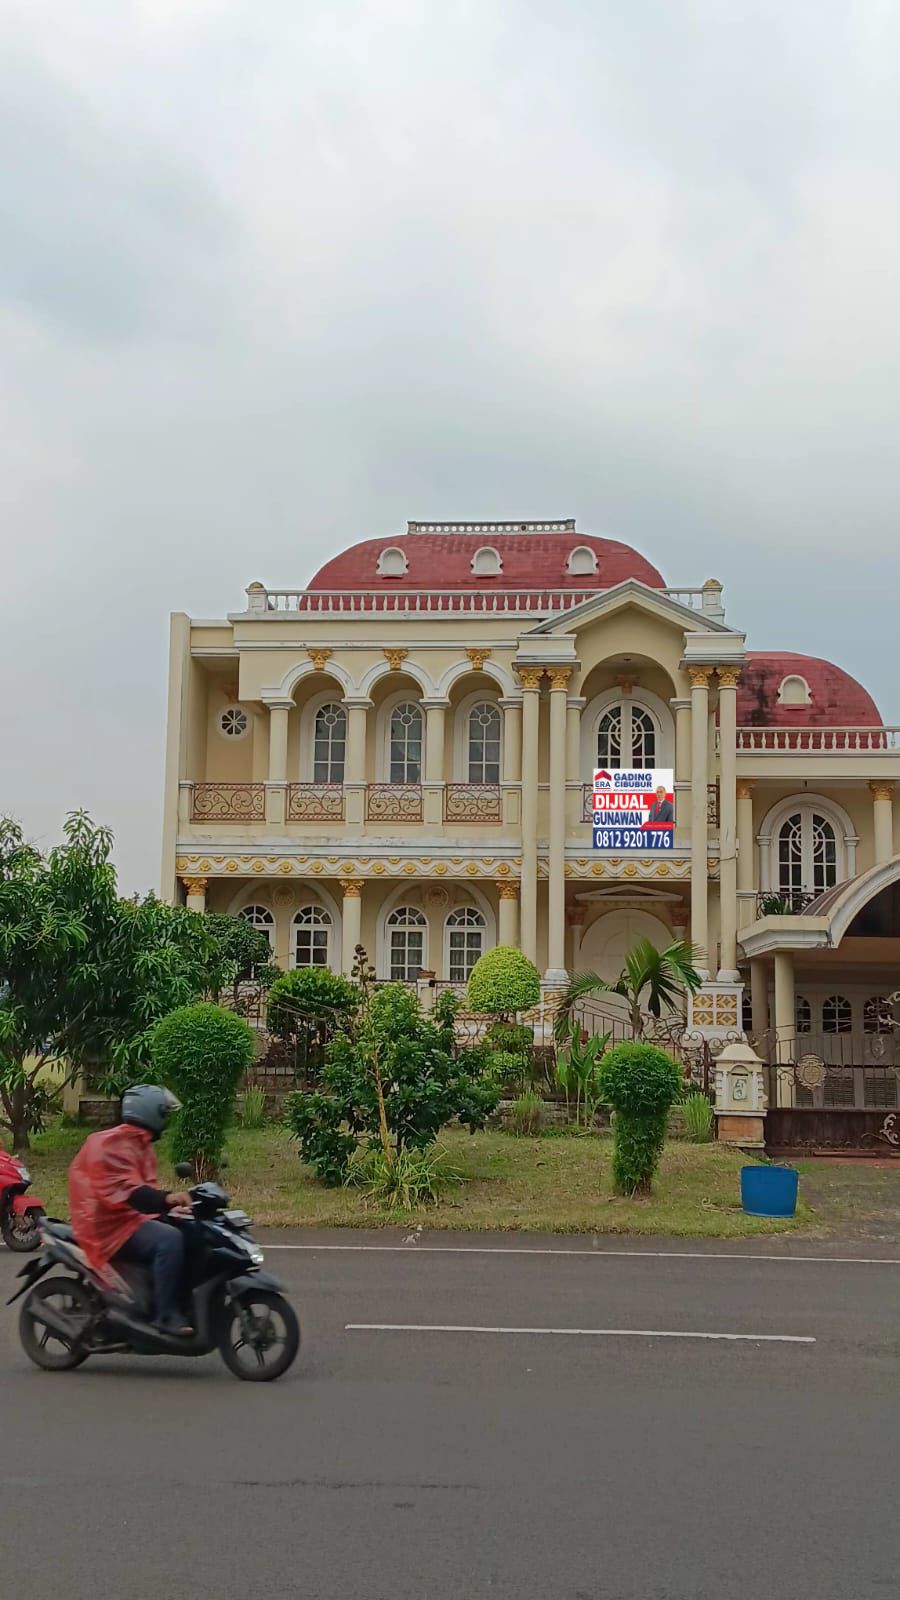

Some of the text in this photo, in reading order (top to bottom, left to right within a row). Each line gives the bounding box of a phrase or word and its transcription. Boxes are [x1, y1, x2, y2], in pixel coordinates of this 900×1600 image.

[613, 773, 652, 781] GADING
[595, 794, 648, 809] DIJUAL
[593, 811, 642, 825] GUNAWAN
[596, 831, 670, 847] 0812 9201 776
